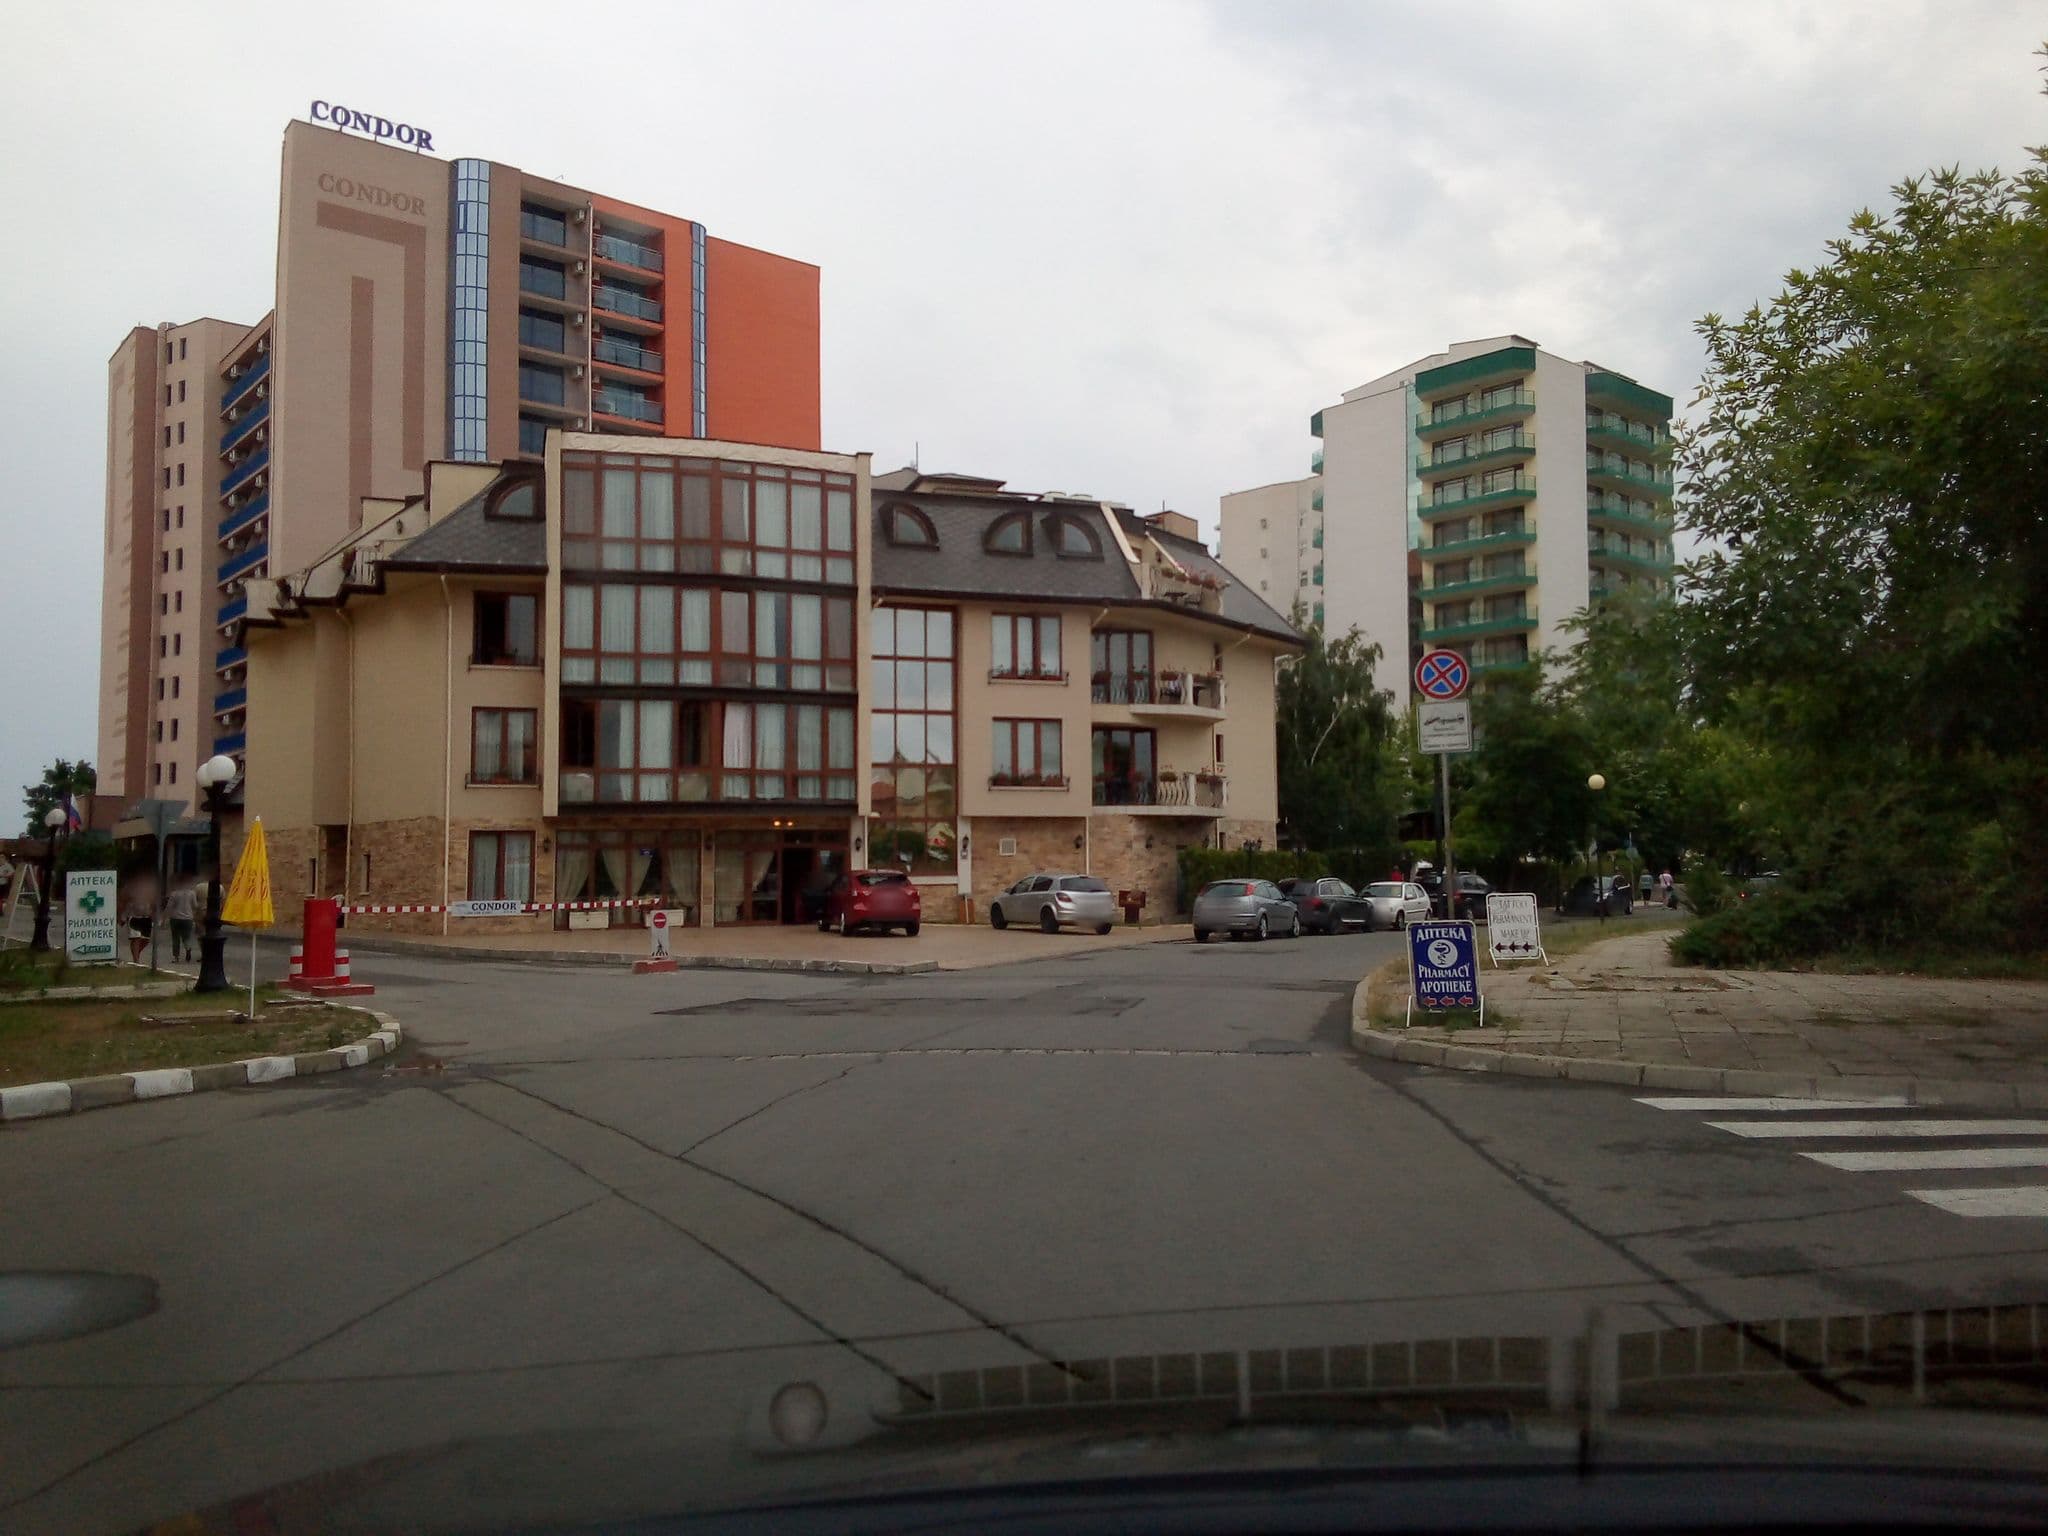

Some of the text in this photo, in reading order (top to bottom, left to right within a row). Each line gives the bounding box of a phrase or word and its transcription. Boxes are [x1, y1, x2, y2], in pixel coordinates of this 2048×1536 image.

[311, 100, 435, 151] CONDOR
[318, 173, 425, 216] CONDOR
[70, 877, 114, 886] АПТЕКА
[471, 902, 517, 911] CONDOR
[68, 918, 115, 928] PHARMACY
[69, 929, 114, 939] APOTHEKE
[1416, 927, 1467, 943] АПТЕКА
[1418, 963, 1470, 979] PHARMACY
[1420, 980, 1472, 993] APOTHEKE
